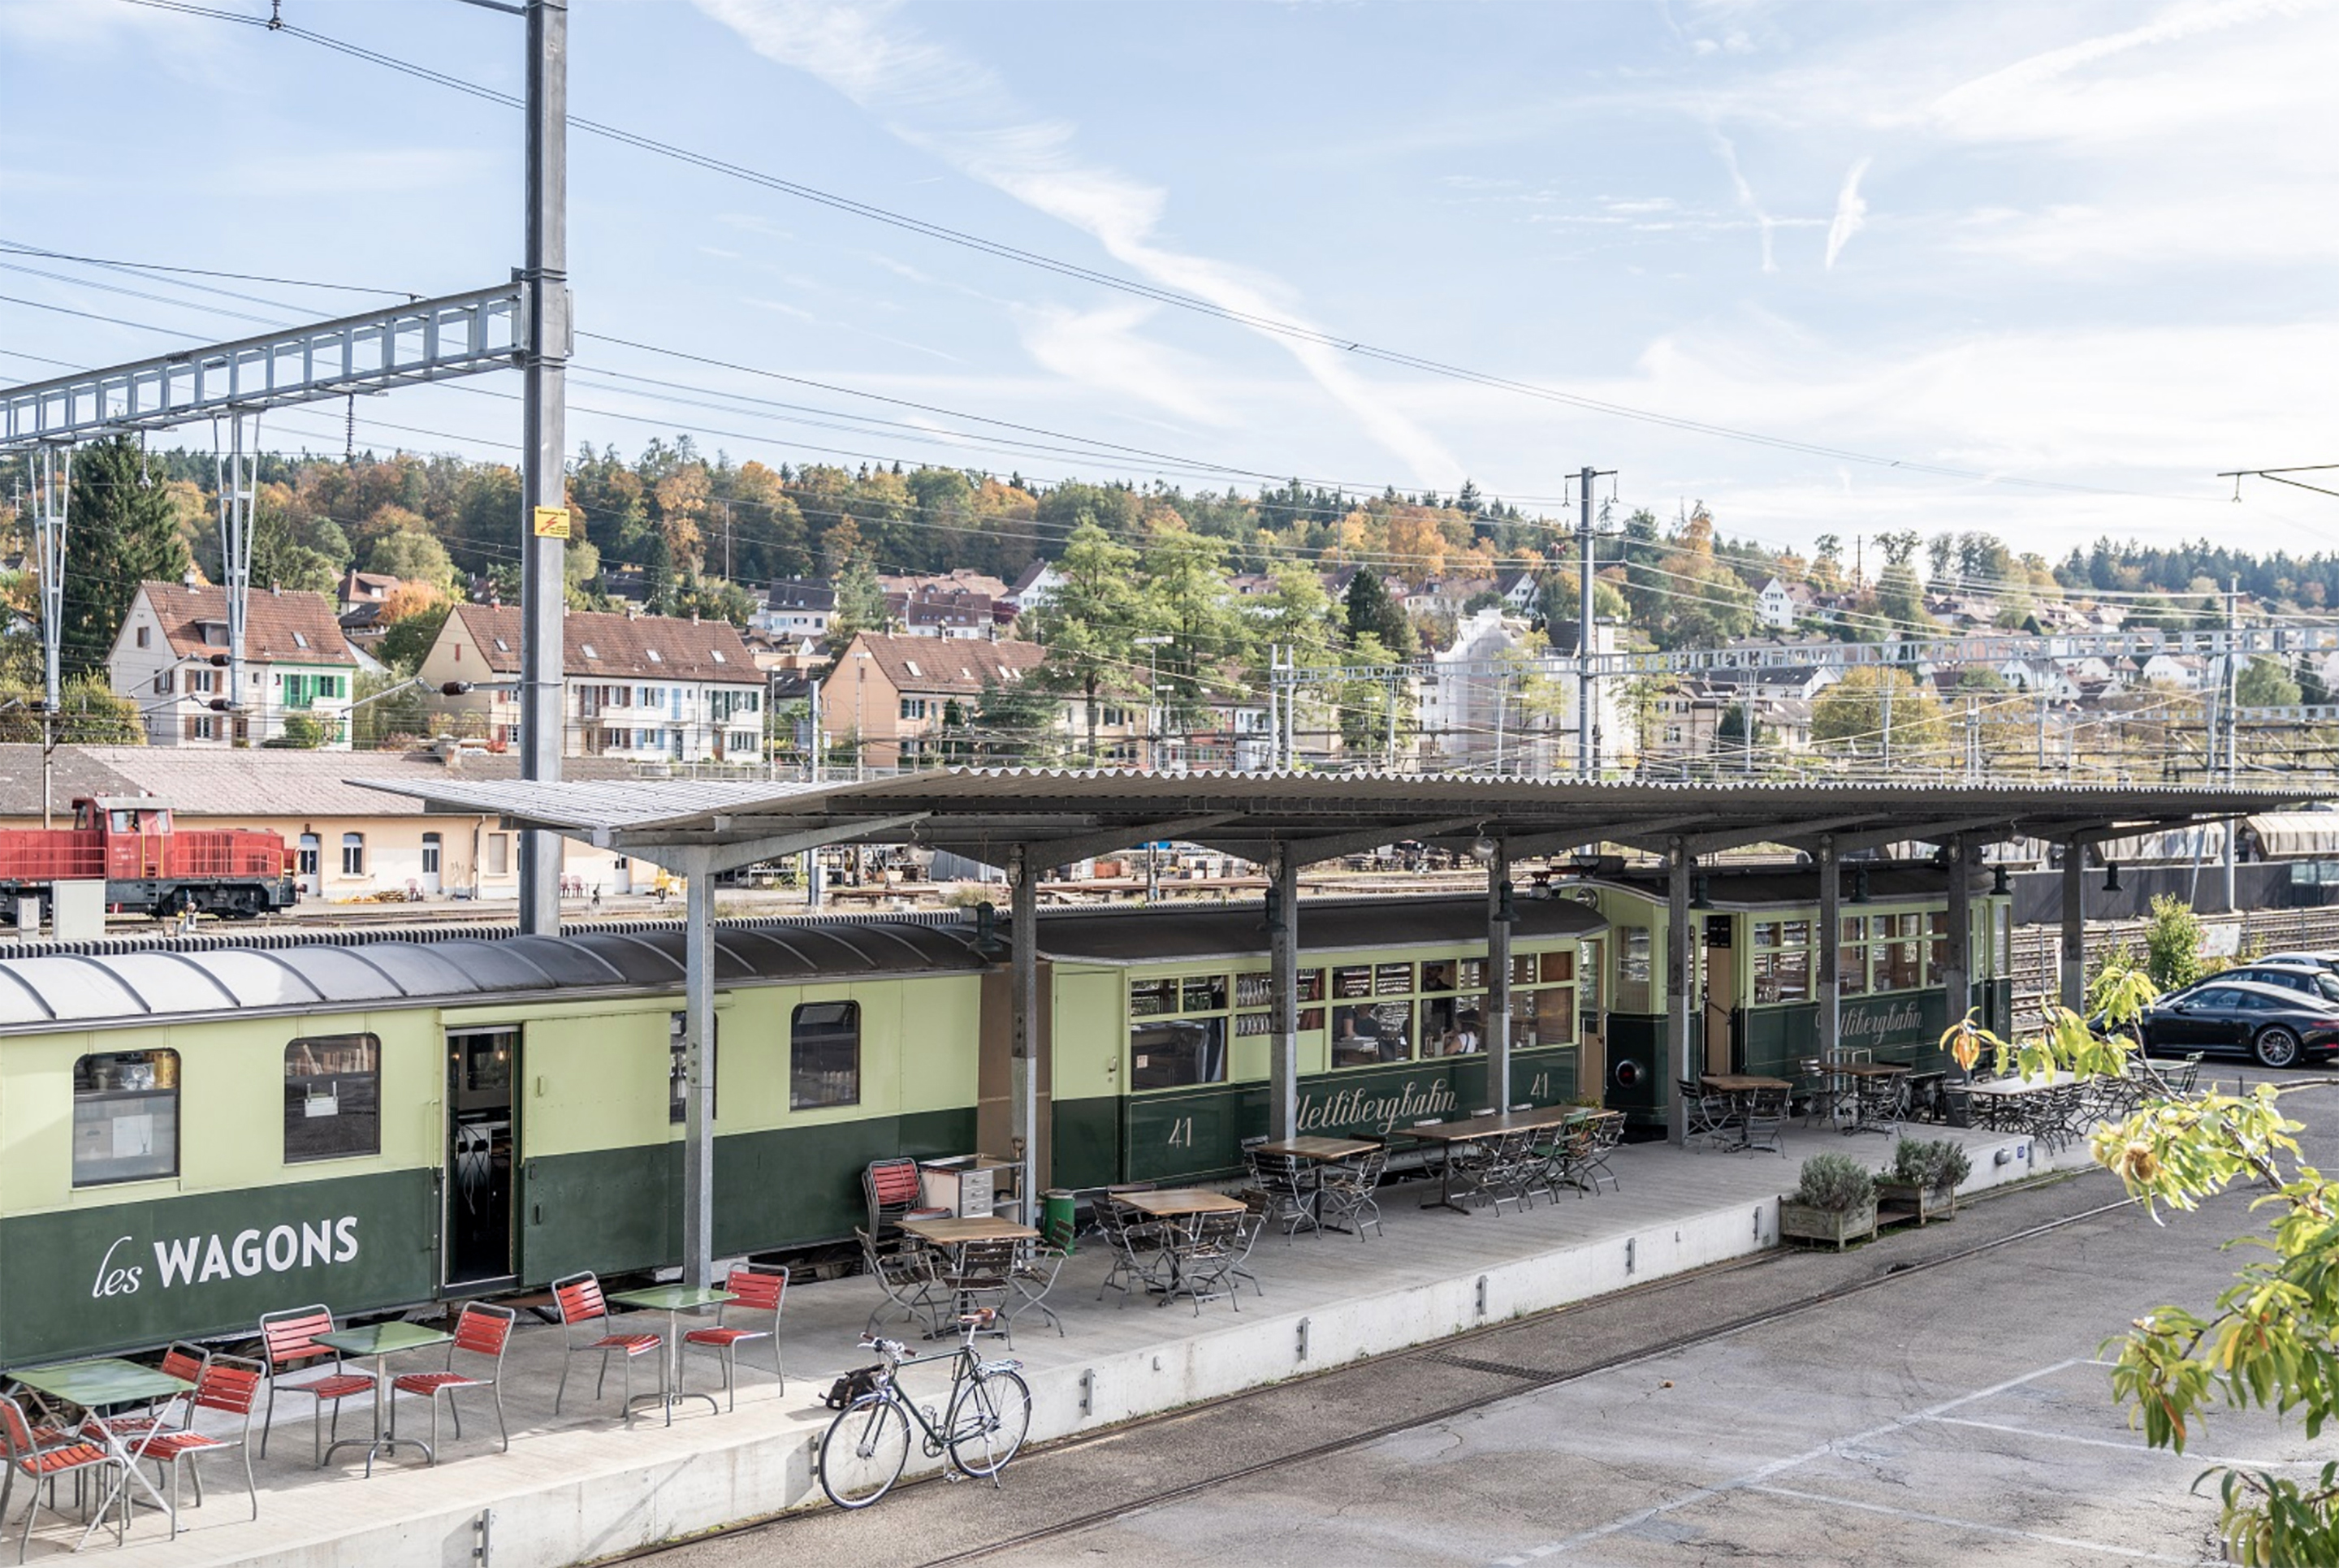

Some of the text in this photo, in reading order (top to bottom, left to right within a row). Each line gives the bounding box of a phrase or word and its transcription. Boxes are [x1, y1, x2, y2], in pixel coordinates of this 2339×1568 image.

[1530, 1072, 1548, 1100] 41
[1168, 1117, 1192, 1148] 41
[92, 1216, 359, 1298] les WAGONS
